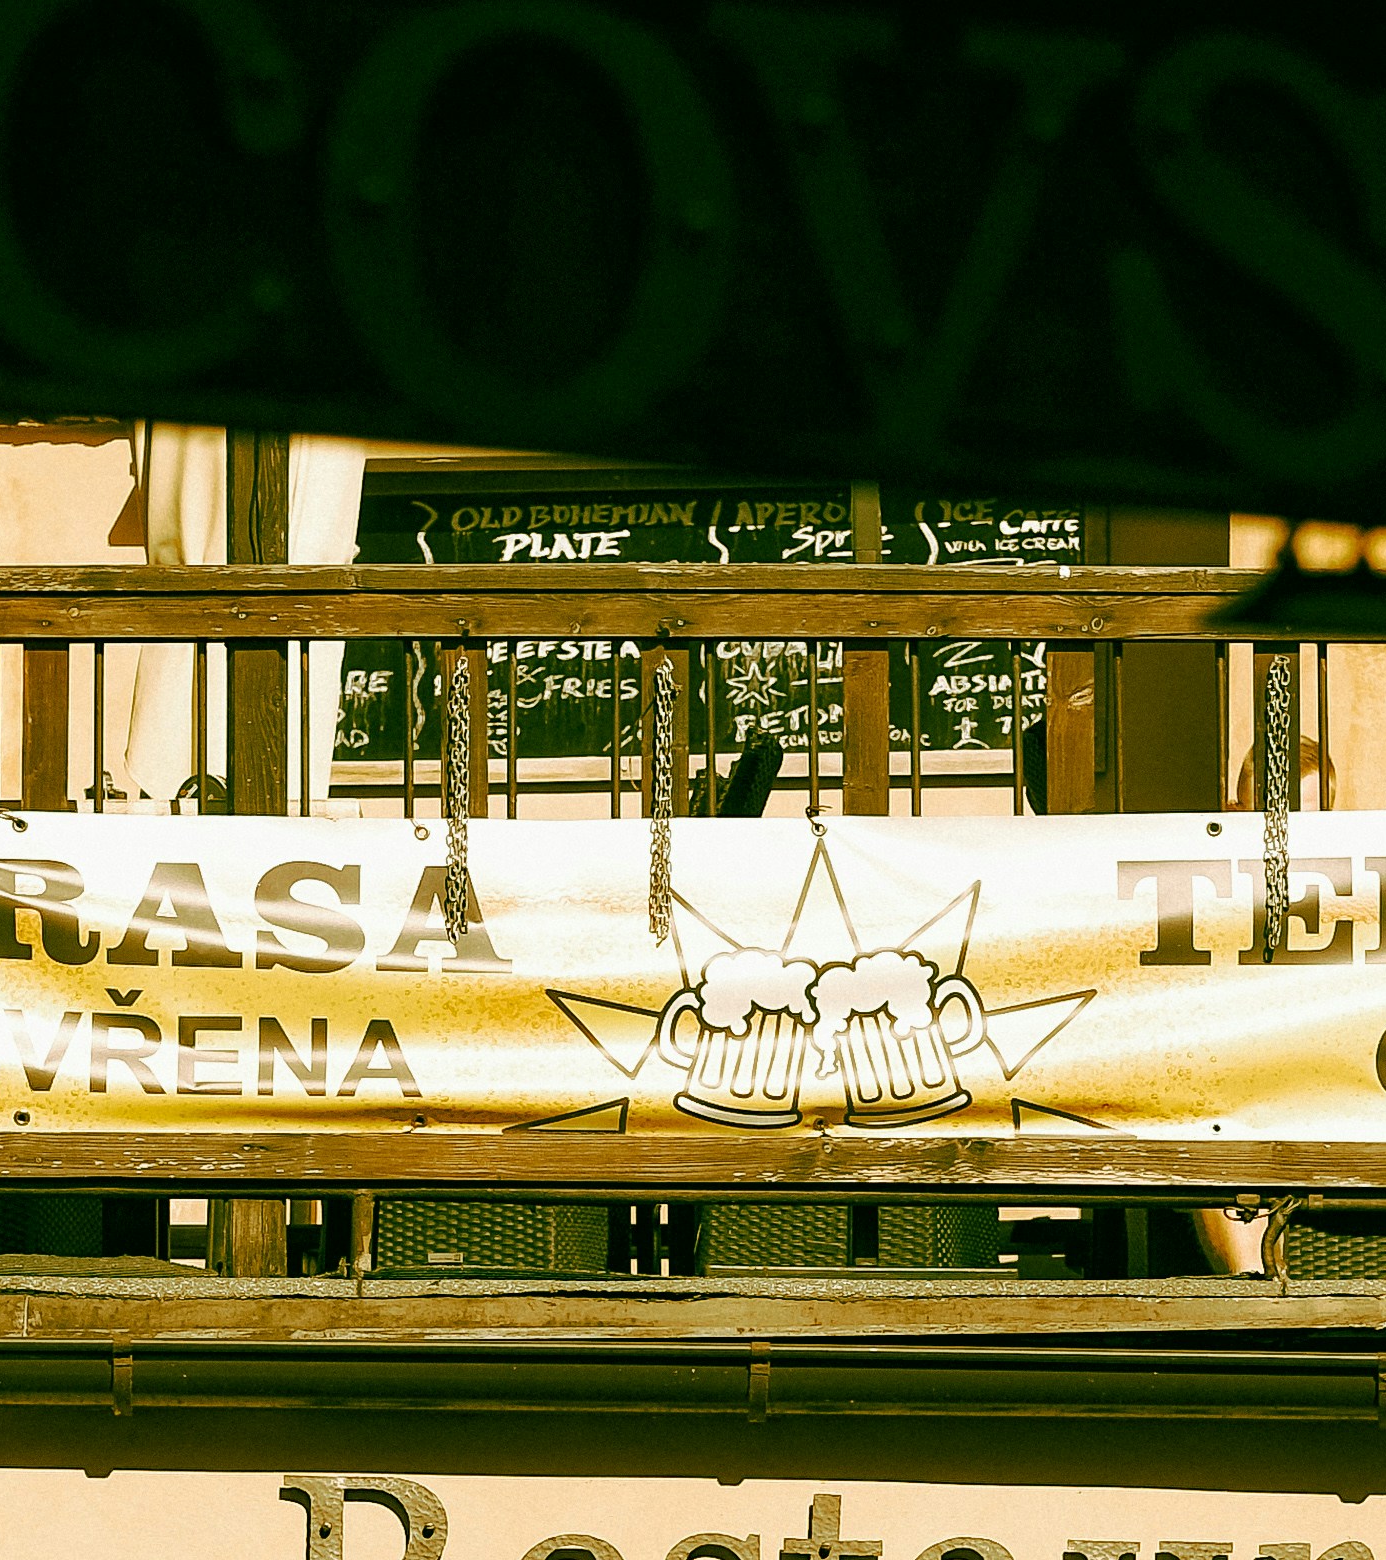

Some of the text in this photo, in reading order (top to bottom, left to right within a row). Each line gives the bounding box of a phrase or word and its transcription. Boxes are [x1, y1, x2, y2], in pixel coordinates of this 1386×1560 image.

[451, 501, 697, 531] OLD BOHEMIAN
[492, 528, 631, 562] PLATE
[543, 674, 640, 700] FRIES
